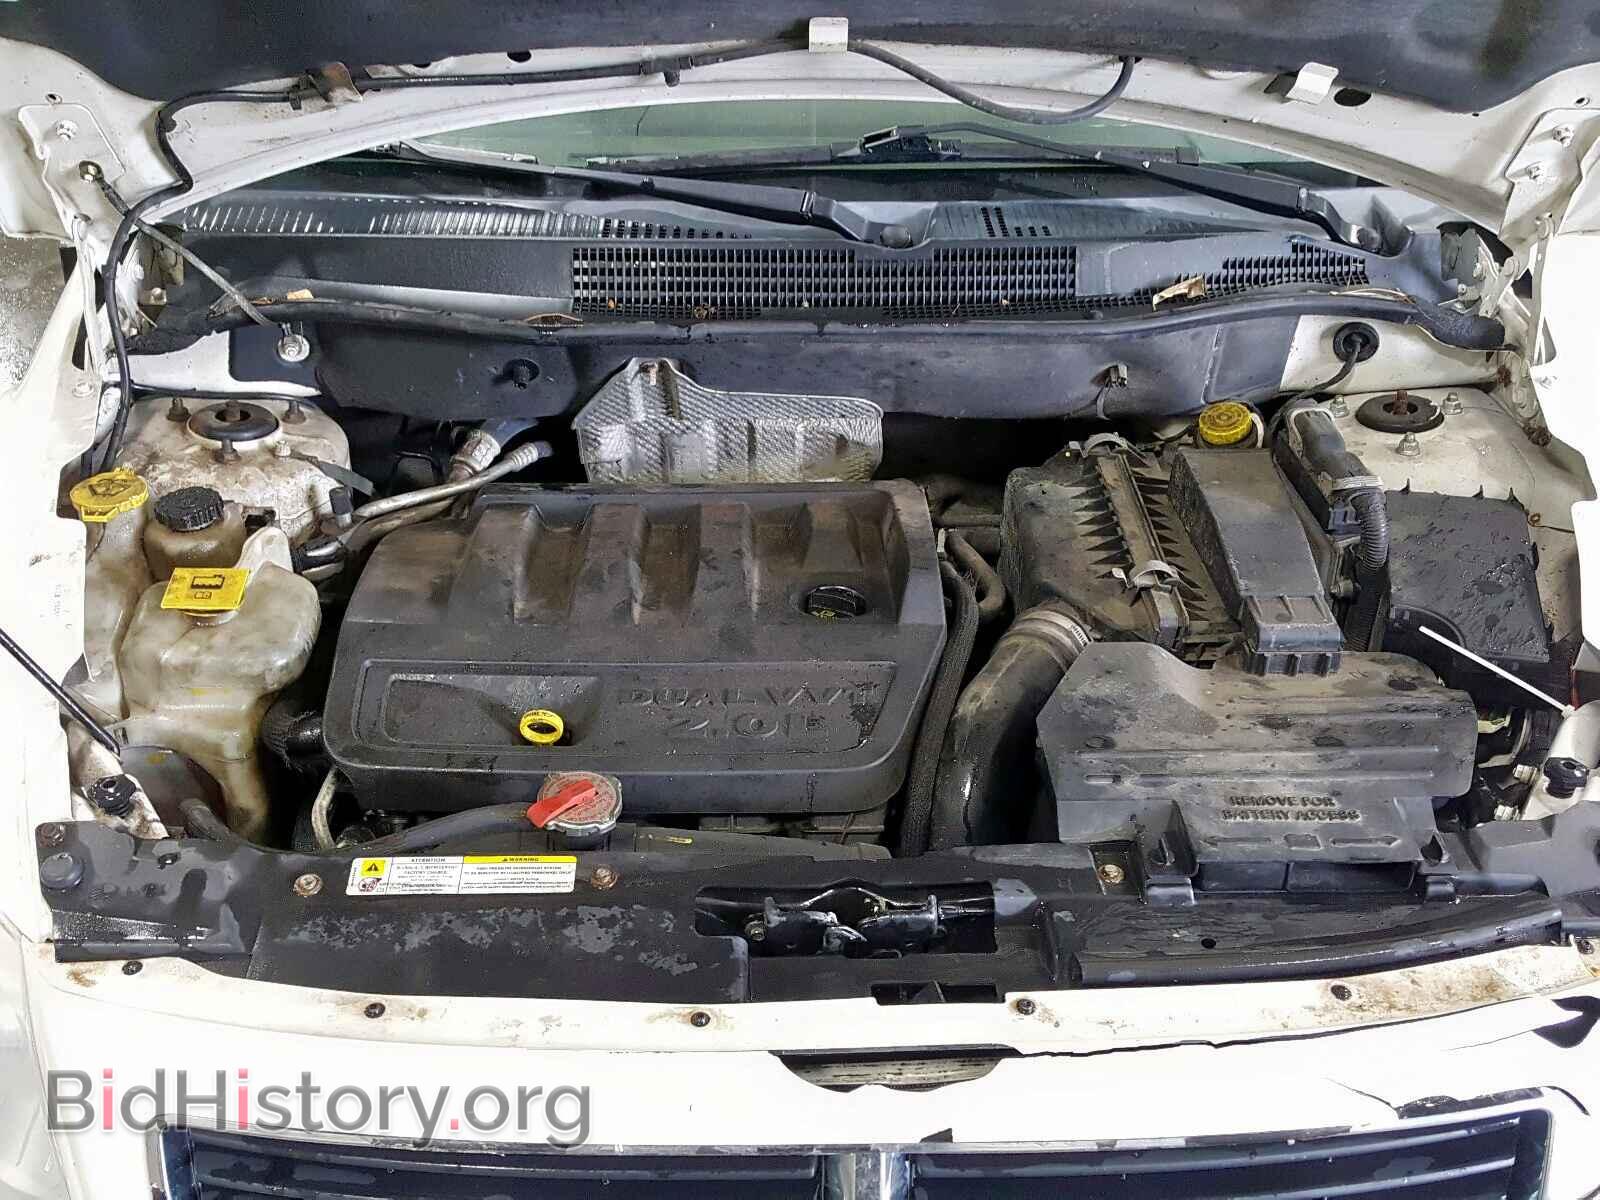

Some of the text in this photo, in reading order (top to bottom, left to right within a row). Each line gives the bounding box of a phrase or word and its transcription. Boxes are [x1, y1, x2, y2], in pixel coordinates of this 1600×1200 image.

[1229, 795, 1336, 807] REMOVE FOR
[1222, 809, 1361, 821] BATTERY ACCESS
